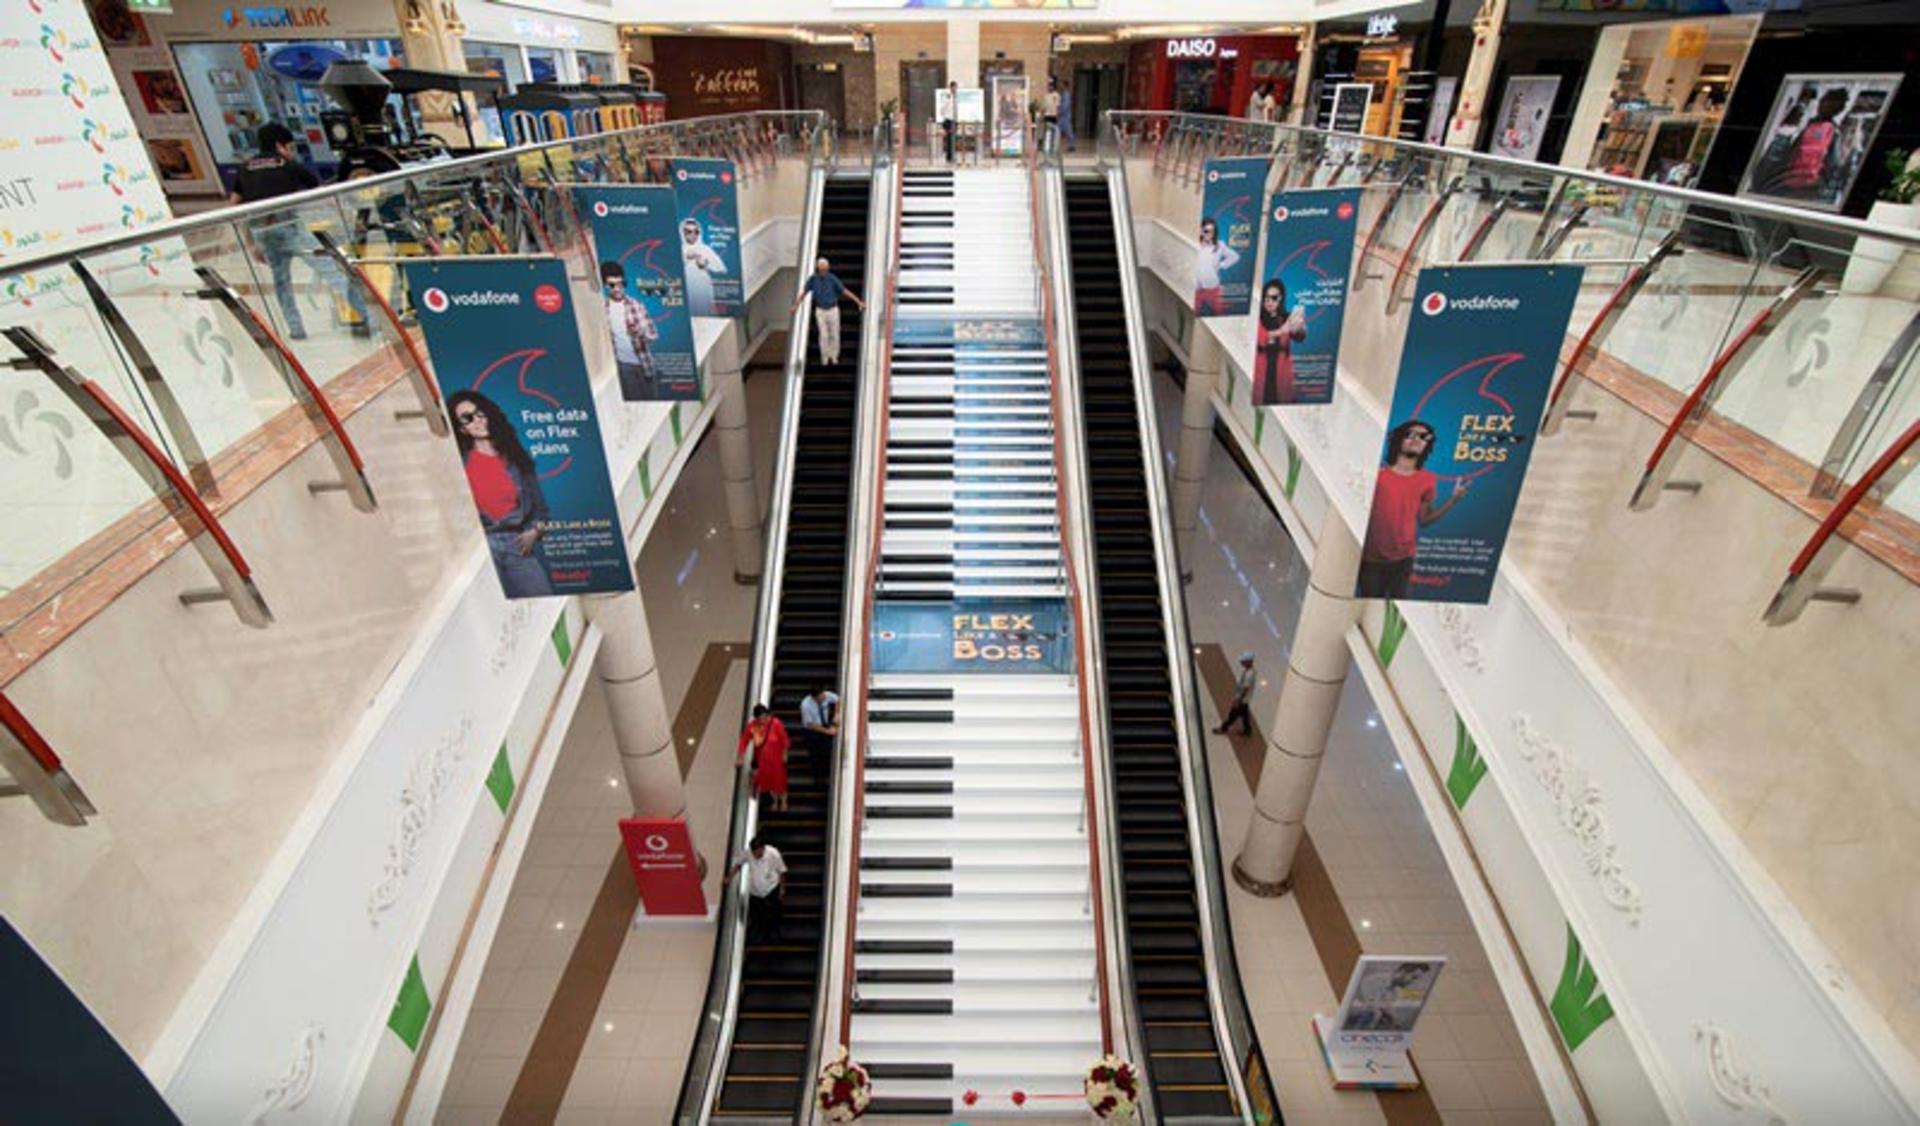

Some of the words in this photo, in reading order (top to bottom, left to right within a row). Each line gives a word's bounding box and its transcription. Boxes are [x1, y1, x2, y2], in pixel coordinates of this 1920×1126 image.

[1167, 38, 1215, 58] DAISO
[610, 204, 648, 214] vodafone
[1290, 207, 1330, 217] vodafone
[451, 291, 520, 306] vodafone
[1450, 296, 1520, 310] vodafone
[521, 408, 553, 423] Free
[556, 408, 588, 422] data
[1460, 415, 1515, 432] FLEX
[526, 428, 546, 439] on
[548, 426, 579, 438] Flex
[530, 443, 570, 458] plans
[953, 614, 1034, 630] FLEX
